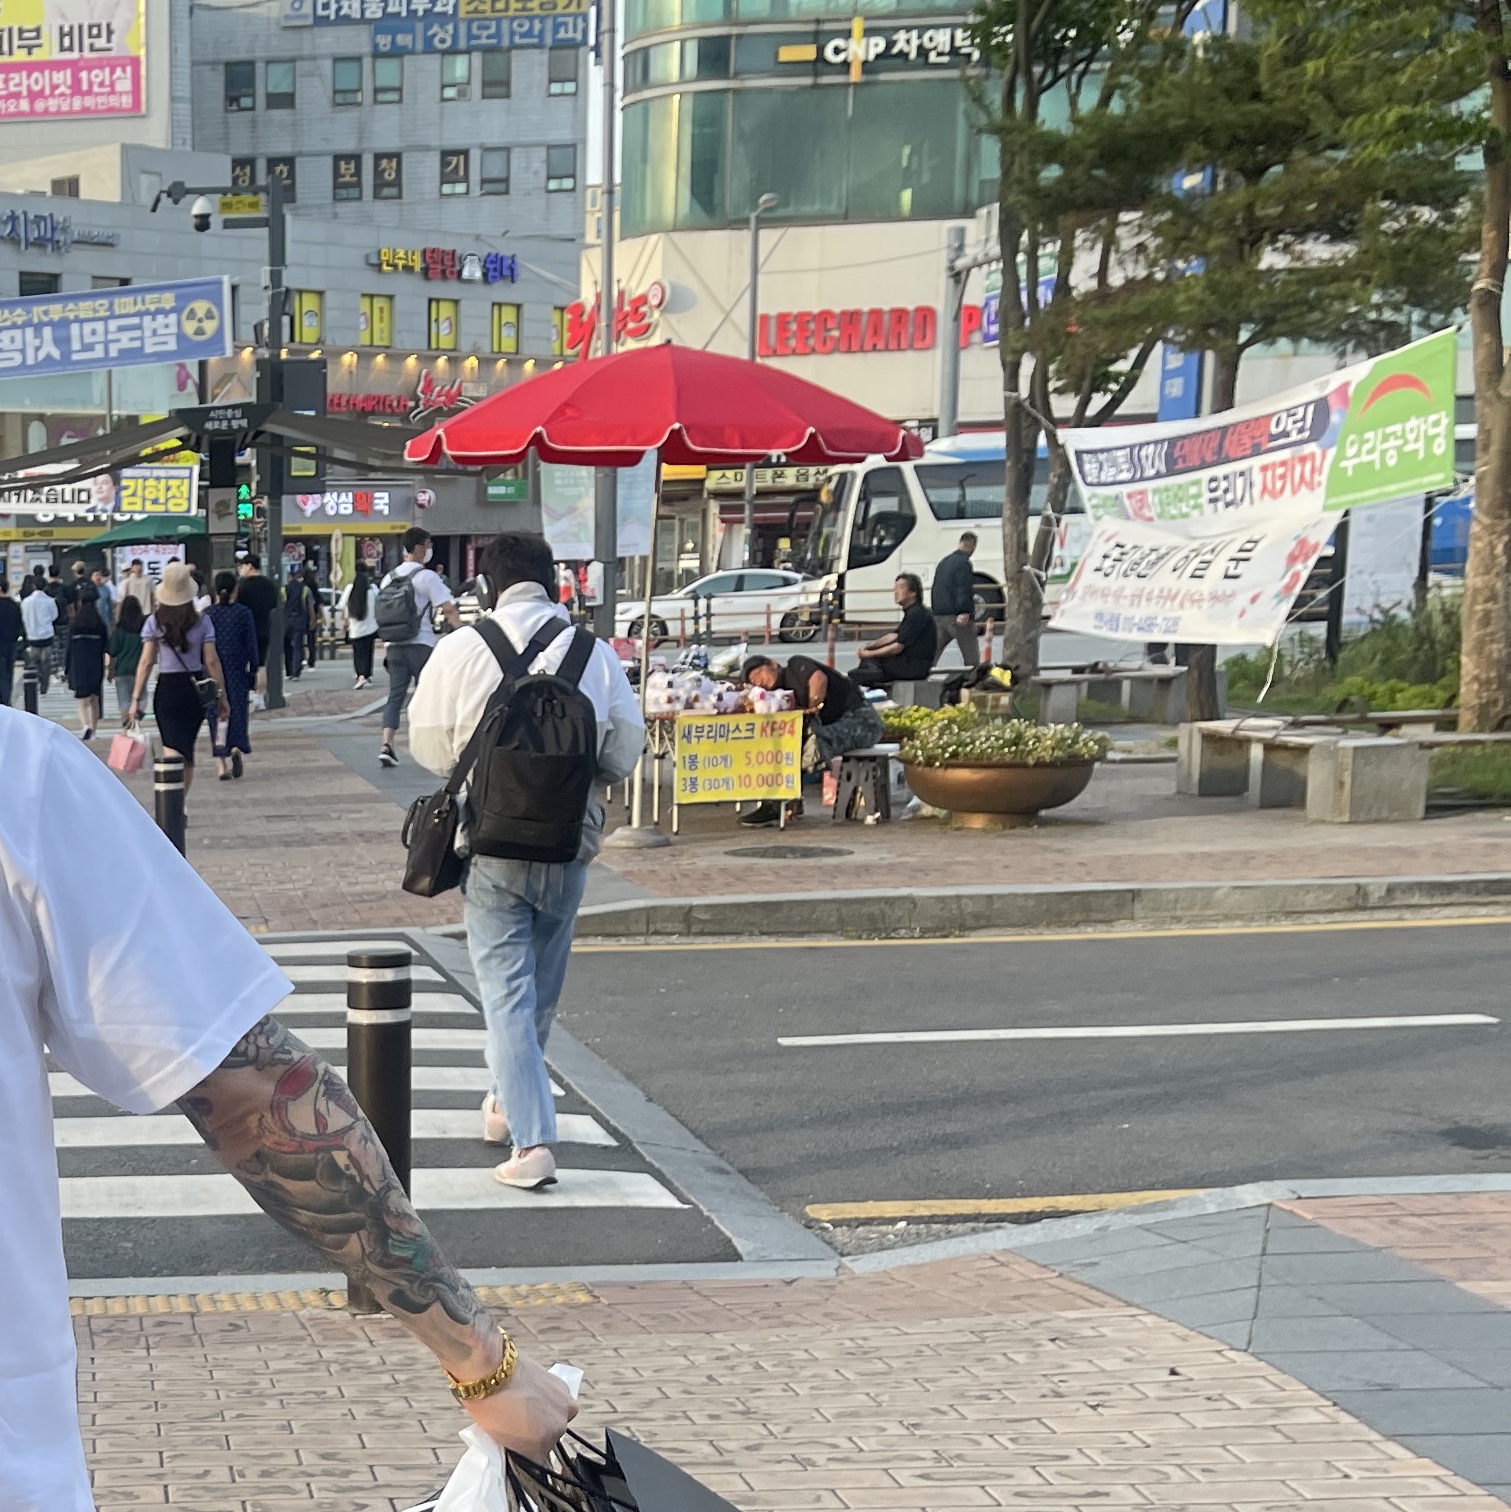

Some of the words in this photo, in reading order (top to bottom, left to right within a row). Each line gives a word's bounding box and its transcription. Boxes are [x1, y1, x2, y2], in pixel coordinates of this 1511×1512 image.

[57, 21, 115, 54] 비만
[426, 15, 587, 49] 성모안과
[823, 35, 887, 65] CNP
[77, 65, 134, 95] 1인실
[757, 305, 937, 358] LEECHARD
[1338, 409, 1451, 477] 우리공화당
[120, 478, 190, 513] 김현정
[1207, 464, 1257, 513] 우리가
[1258, 448, 1328, 501] 지키자!
[681, 721, 756, 745] 새부리마스크
[759, 718, 797, 739] KF94
[682, 753, 699, 771] 1봉
[681, 776, 699, 794] 3봉
